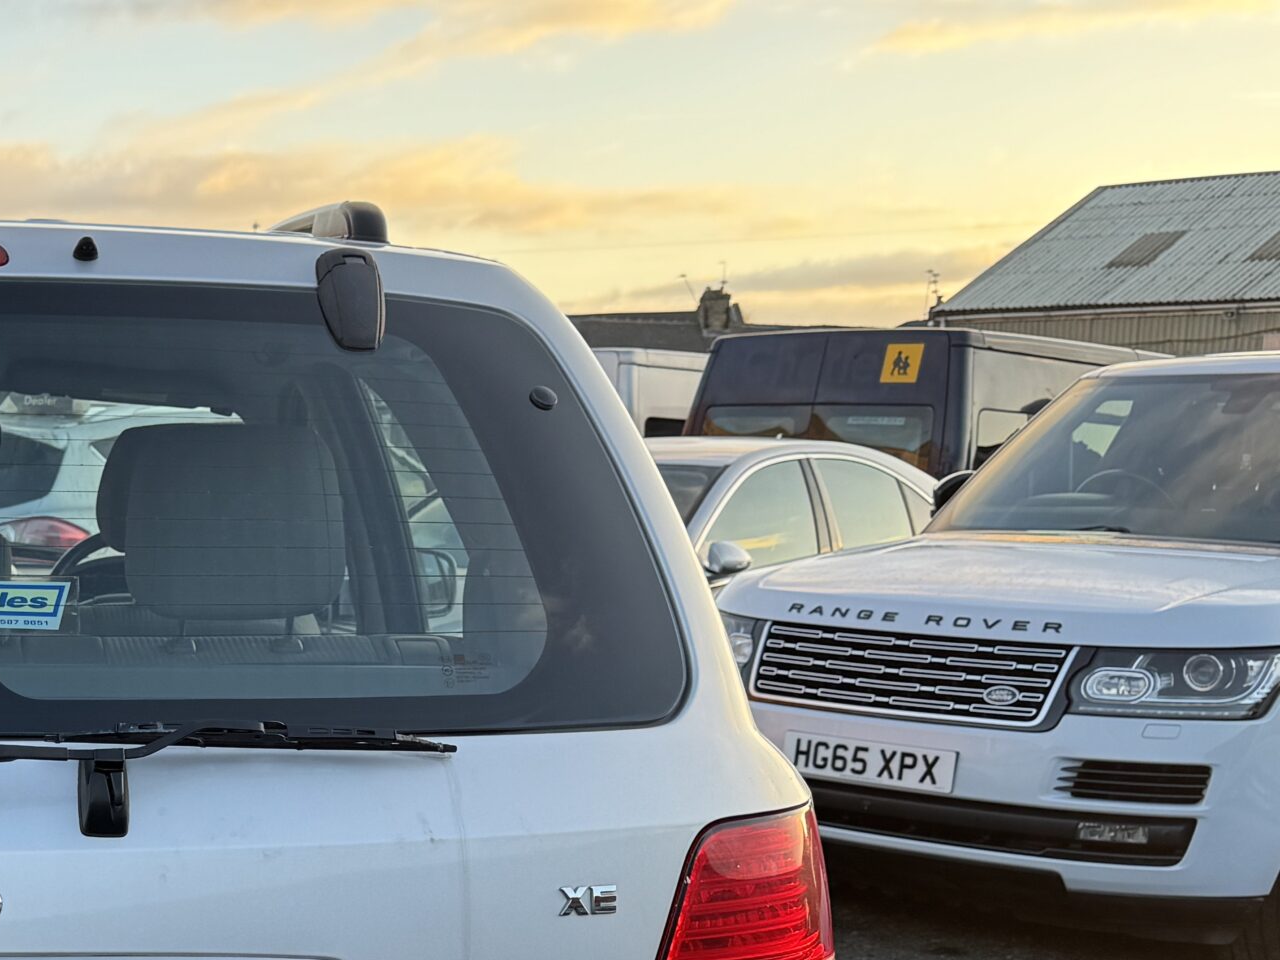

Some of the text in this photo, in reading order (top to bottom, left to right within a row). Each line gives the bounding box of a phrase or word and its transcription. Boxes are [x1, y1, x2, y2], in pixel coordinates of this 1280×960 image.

[788, 602, 1063, 634] RANGE ROVER
[793, 738, 940, 785] HG65 XPX
[559, 885, 617, 916] XE
